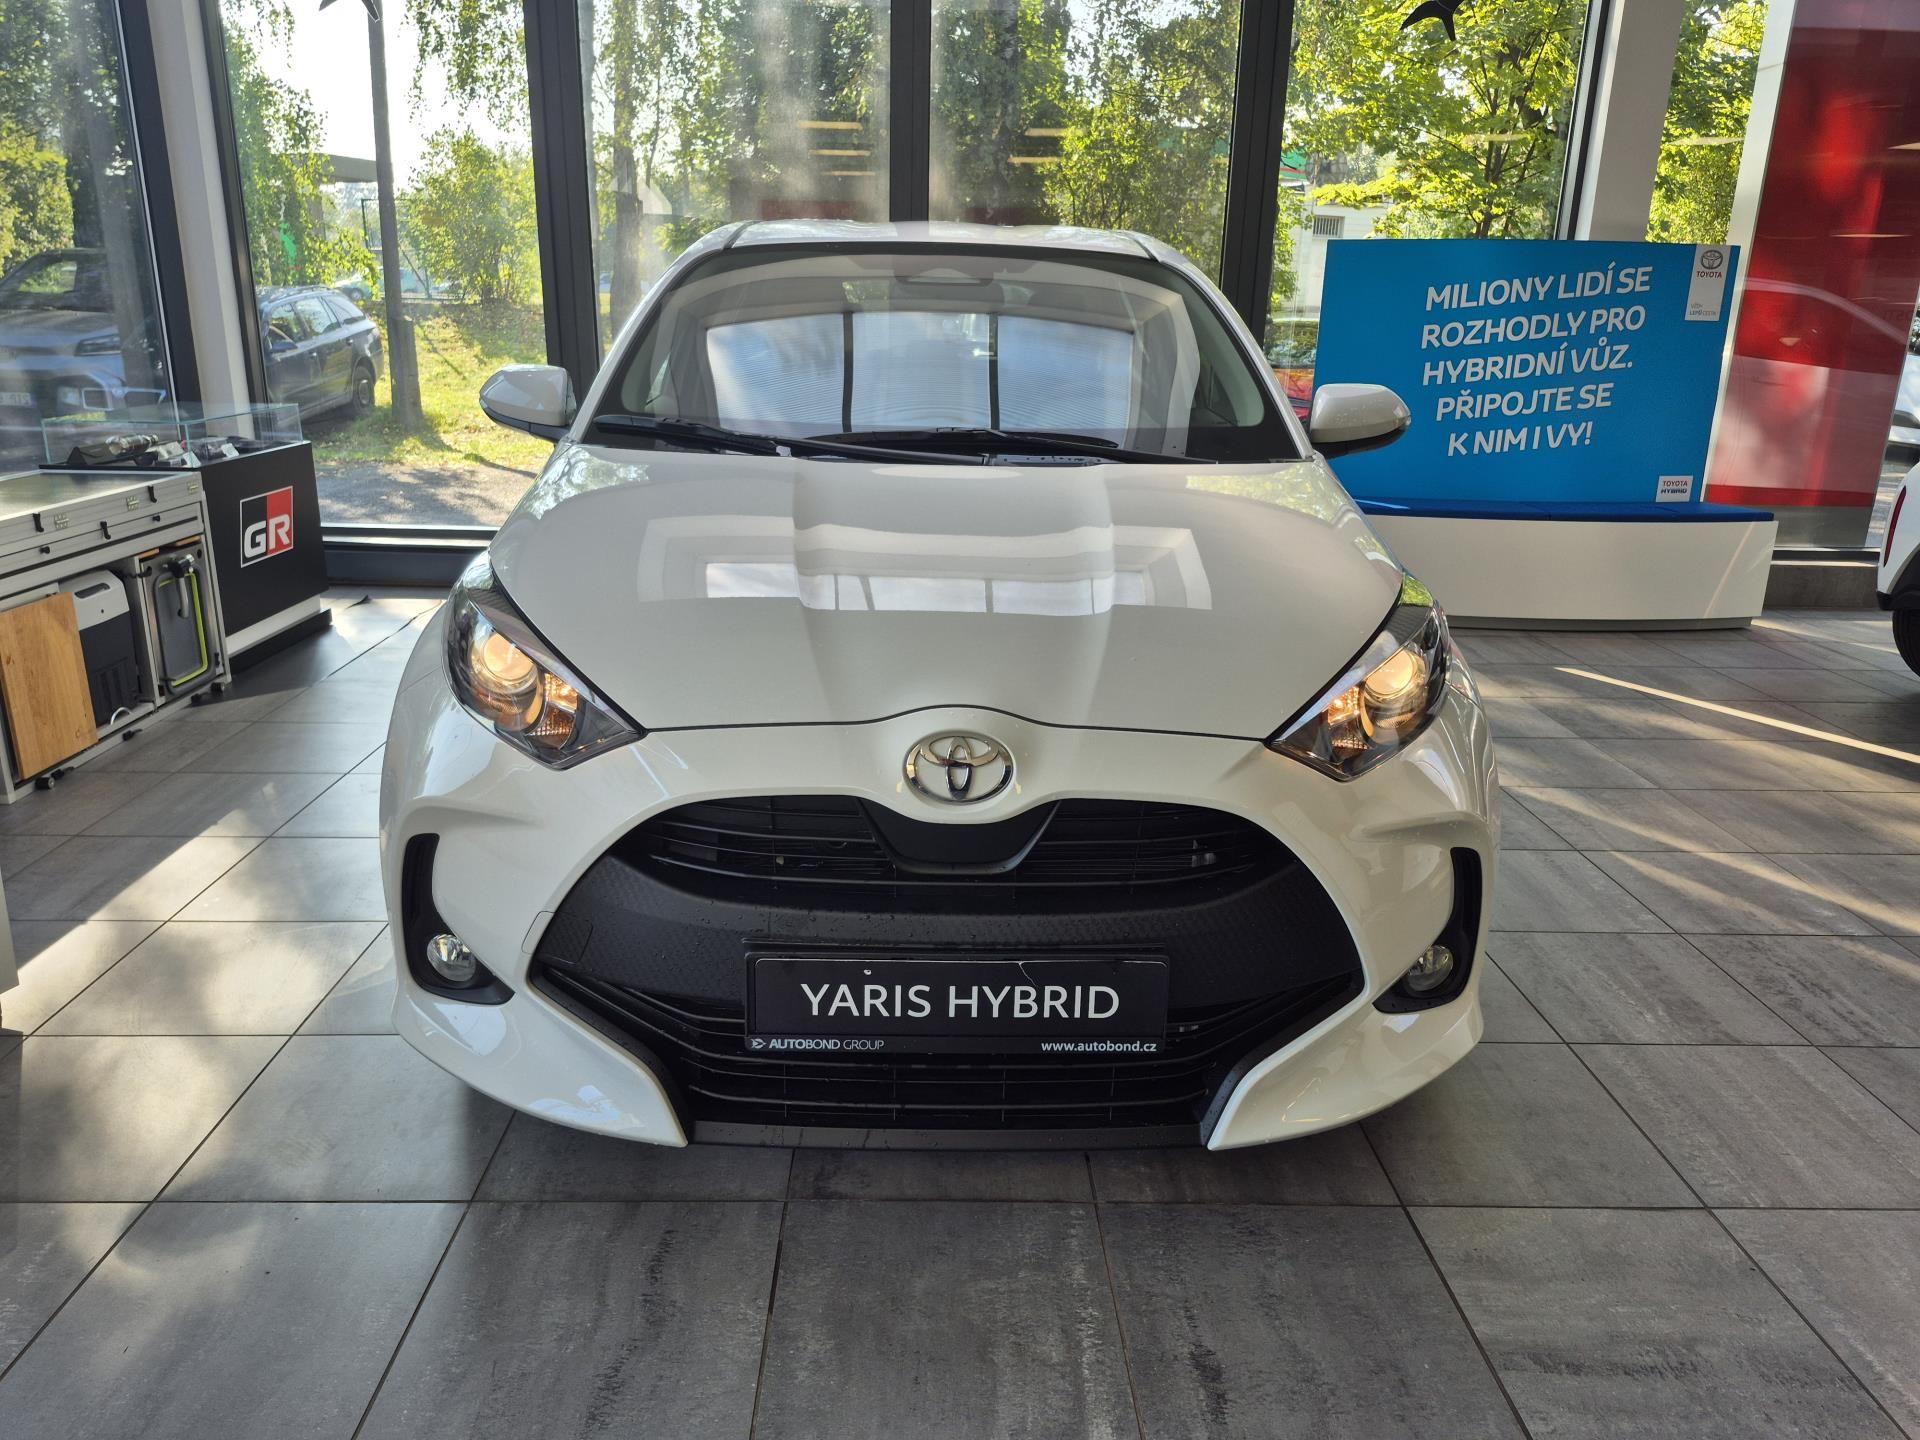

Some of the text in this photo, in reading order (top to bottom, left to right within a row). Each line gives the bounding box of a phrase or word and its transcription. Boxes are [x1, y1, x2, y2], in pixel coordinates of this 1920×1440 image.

[1425, 261, 1653, 311] MILIONY LIDÍ SE
[1696, 270, 1722, 279] TOYOTA
[1421, 305, 1646, 349] ROZHODLY PRO
[1422, 336, 1633, 386] HYBRIDNÍ VŮZ.
[1436, 382, 1614, 421] PŘIPOJTE SE
[1447, 421, 1593, 457] K NIM I VY!
[244, 513, 291, 558] GR
[800, 983, 1120, 1019] YARIS HYBRID
[768, 1038, 885, 1051] AUTOBOND GROUP
[1041, 1040, 1157, 1052] www.autobond.cz
